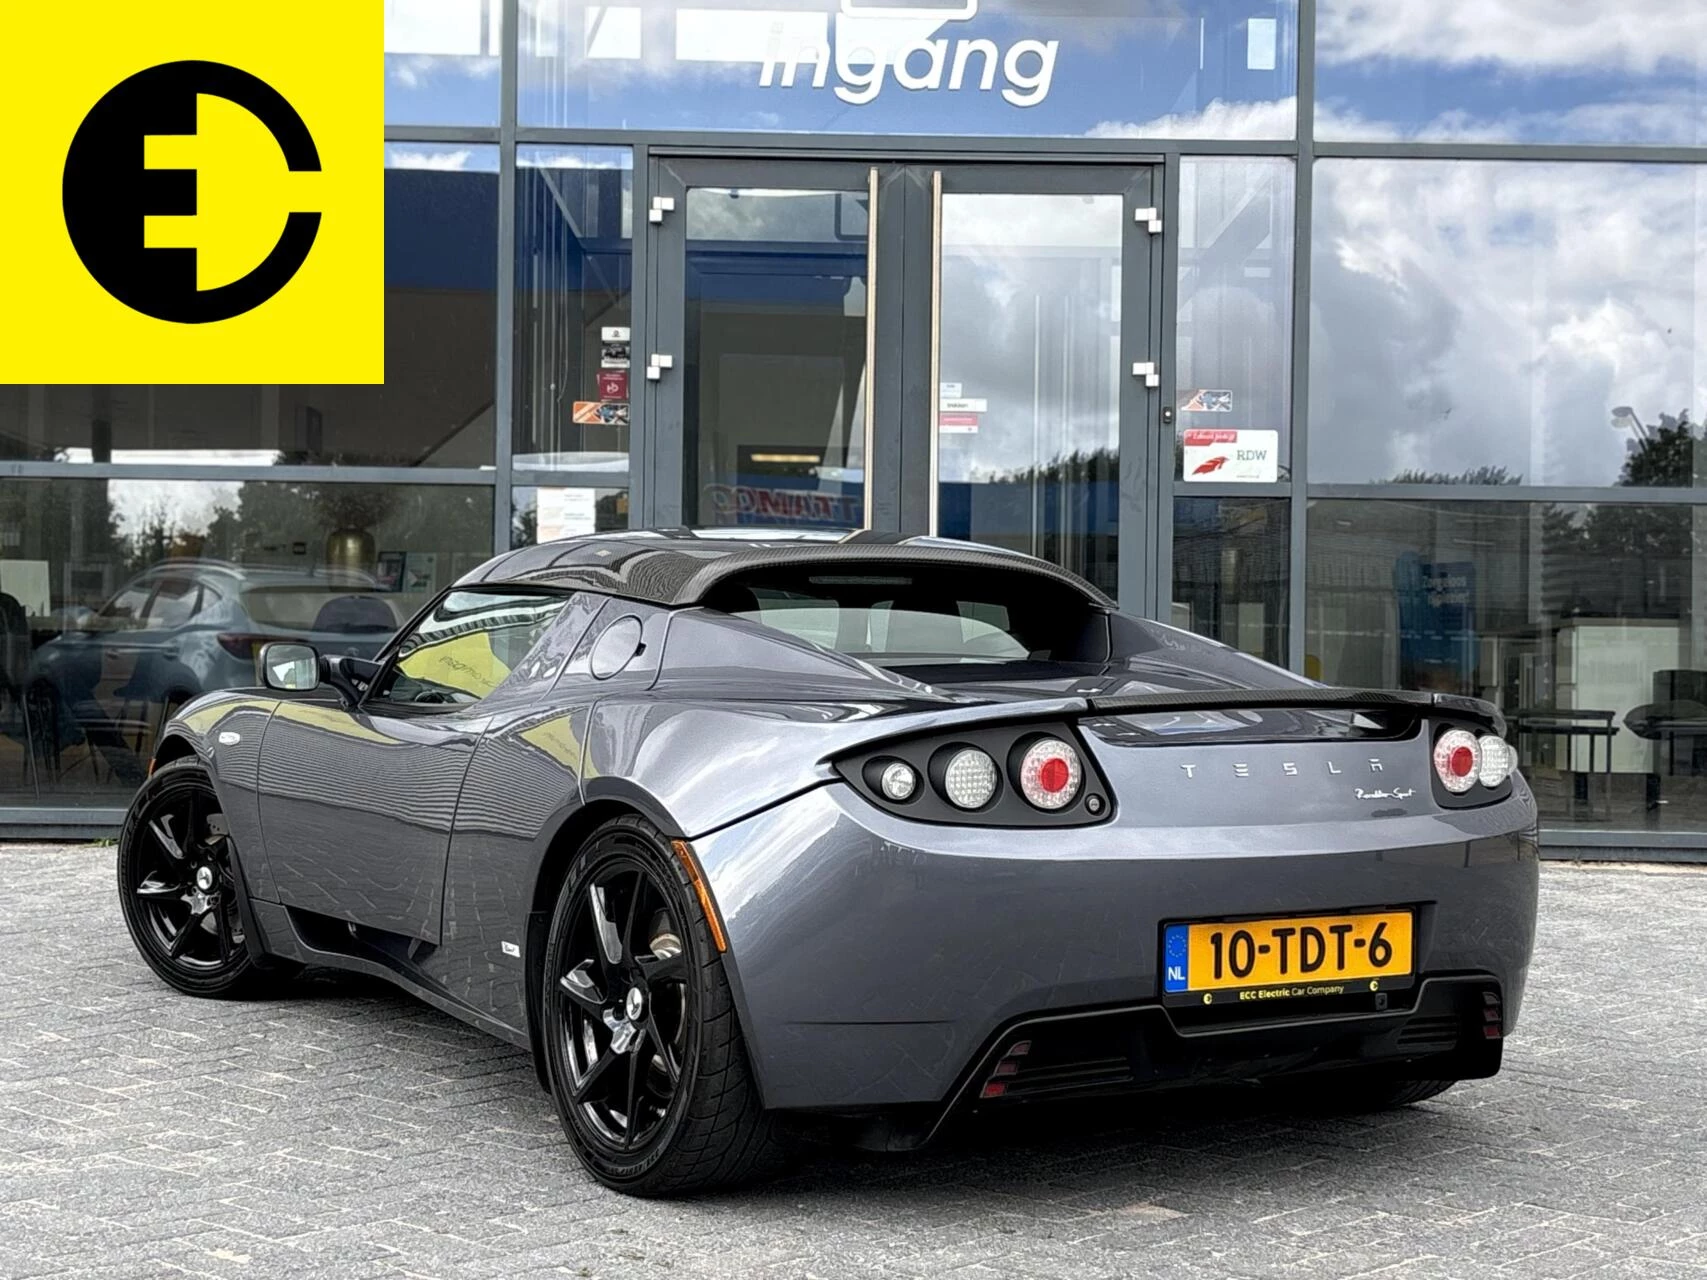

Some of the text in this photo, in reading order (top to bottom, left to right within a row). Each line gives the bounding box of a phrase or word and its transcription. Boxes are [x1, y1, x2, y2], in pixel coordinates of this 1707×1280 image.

[758, 22, 1059, 108] ingang
[1236, 449, 1268, 461] RDW
[1180, 758, 1384, 779] TESLA
[1210, 921, 1393, 980] 10-TDT-6
[1168, 966, 1186, 982] NL
[1239, 984, 1345, 1001] ECC Electric Car Company
